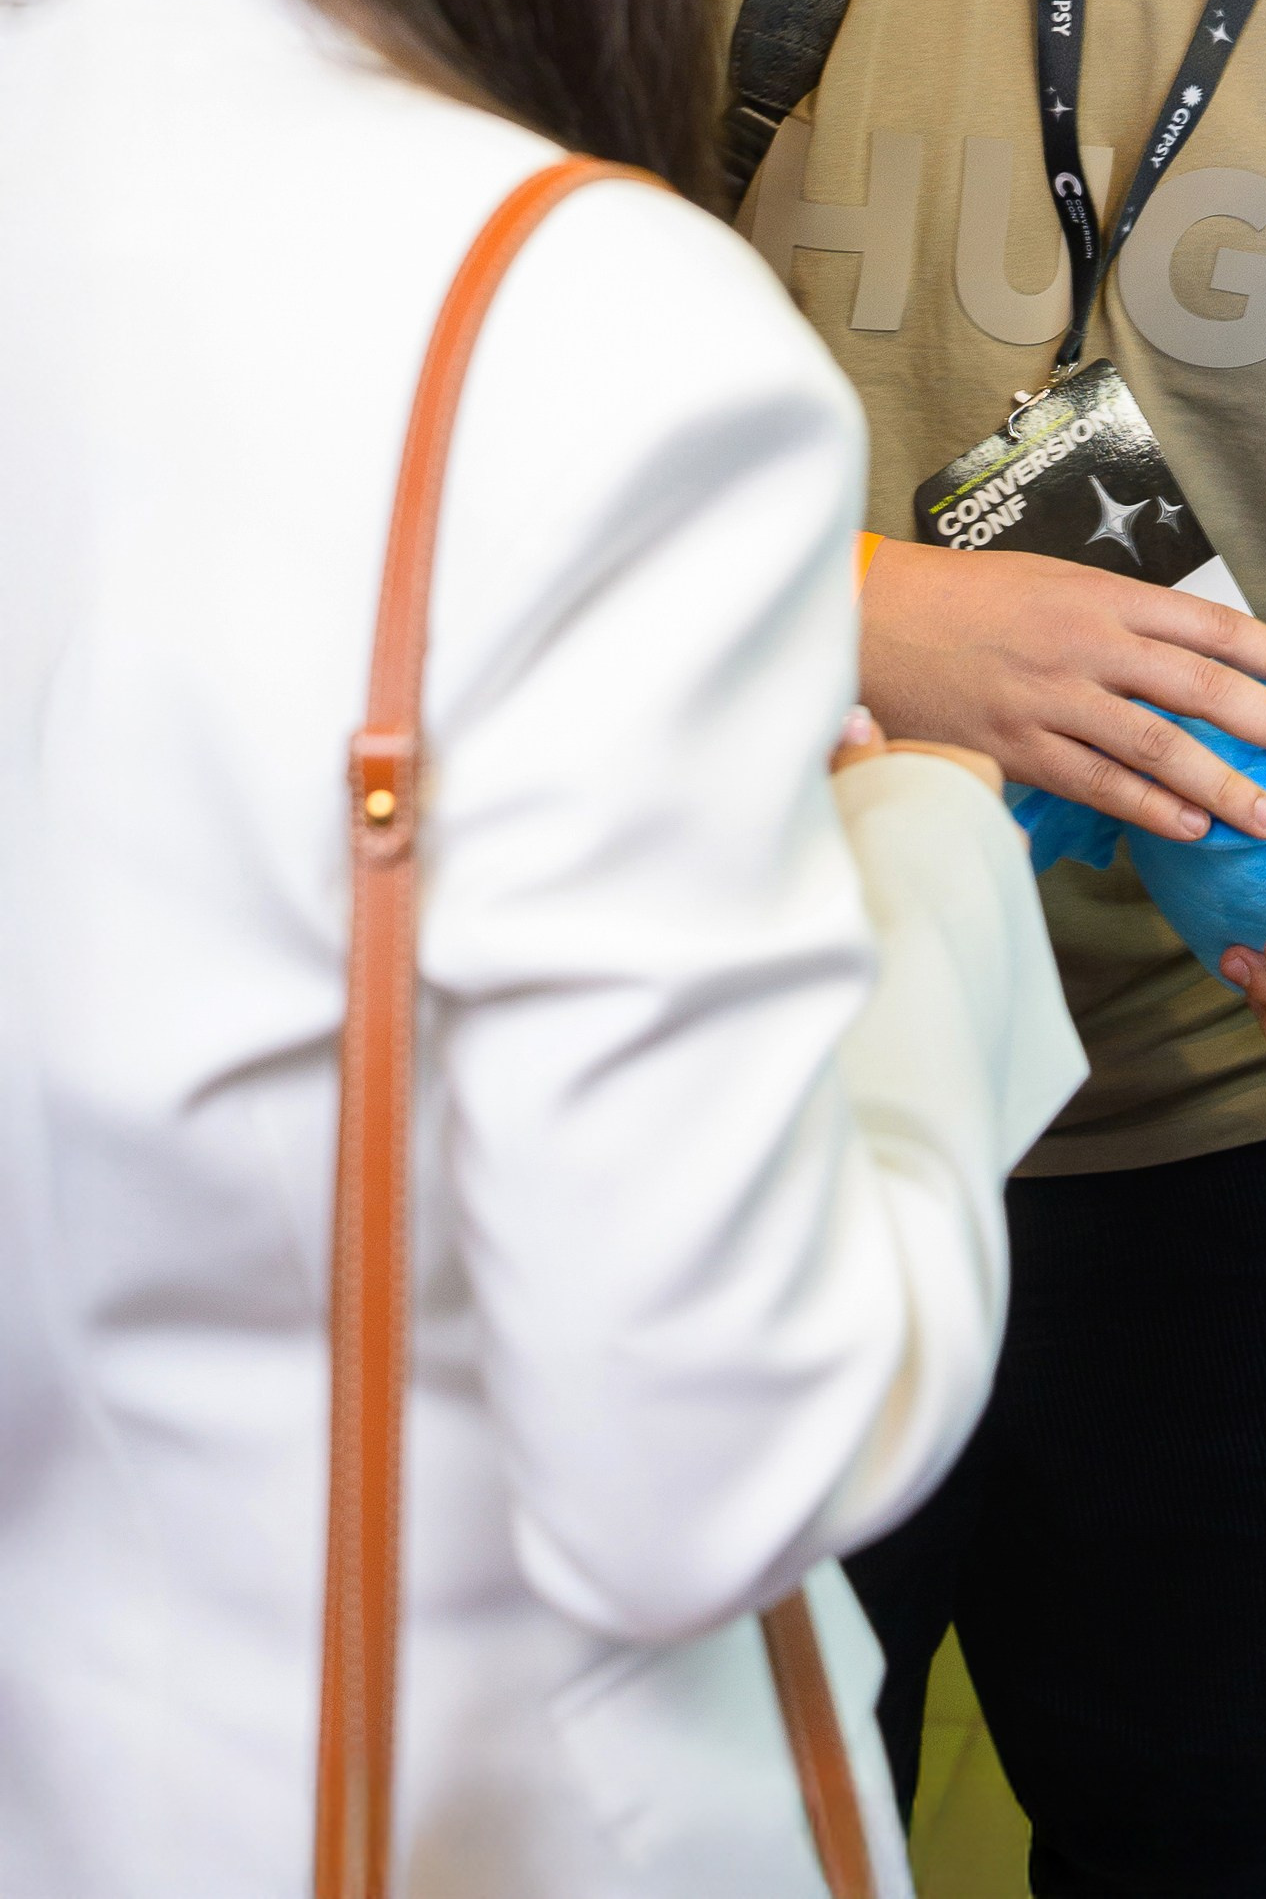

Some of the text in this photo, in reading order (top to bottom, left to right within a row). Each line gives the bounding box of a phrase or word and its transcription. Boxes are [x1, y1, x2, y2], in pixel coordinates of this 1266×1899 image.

[1150, 107, 1191, 169] GYPSY
[1066, 199, 1080, 223] CONF
[1075, 199, 1095, 258] CONVERSION
[936, 405, 1115, 536] CONVERSION
[950, 493, 1028, 551] CONF
